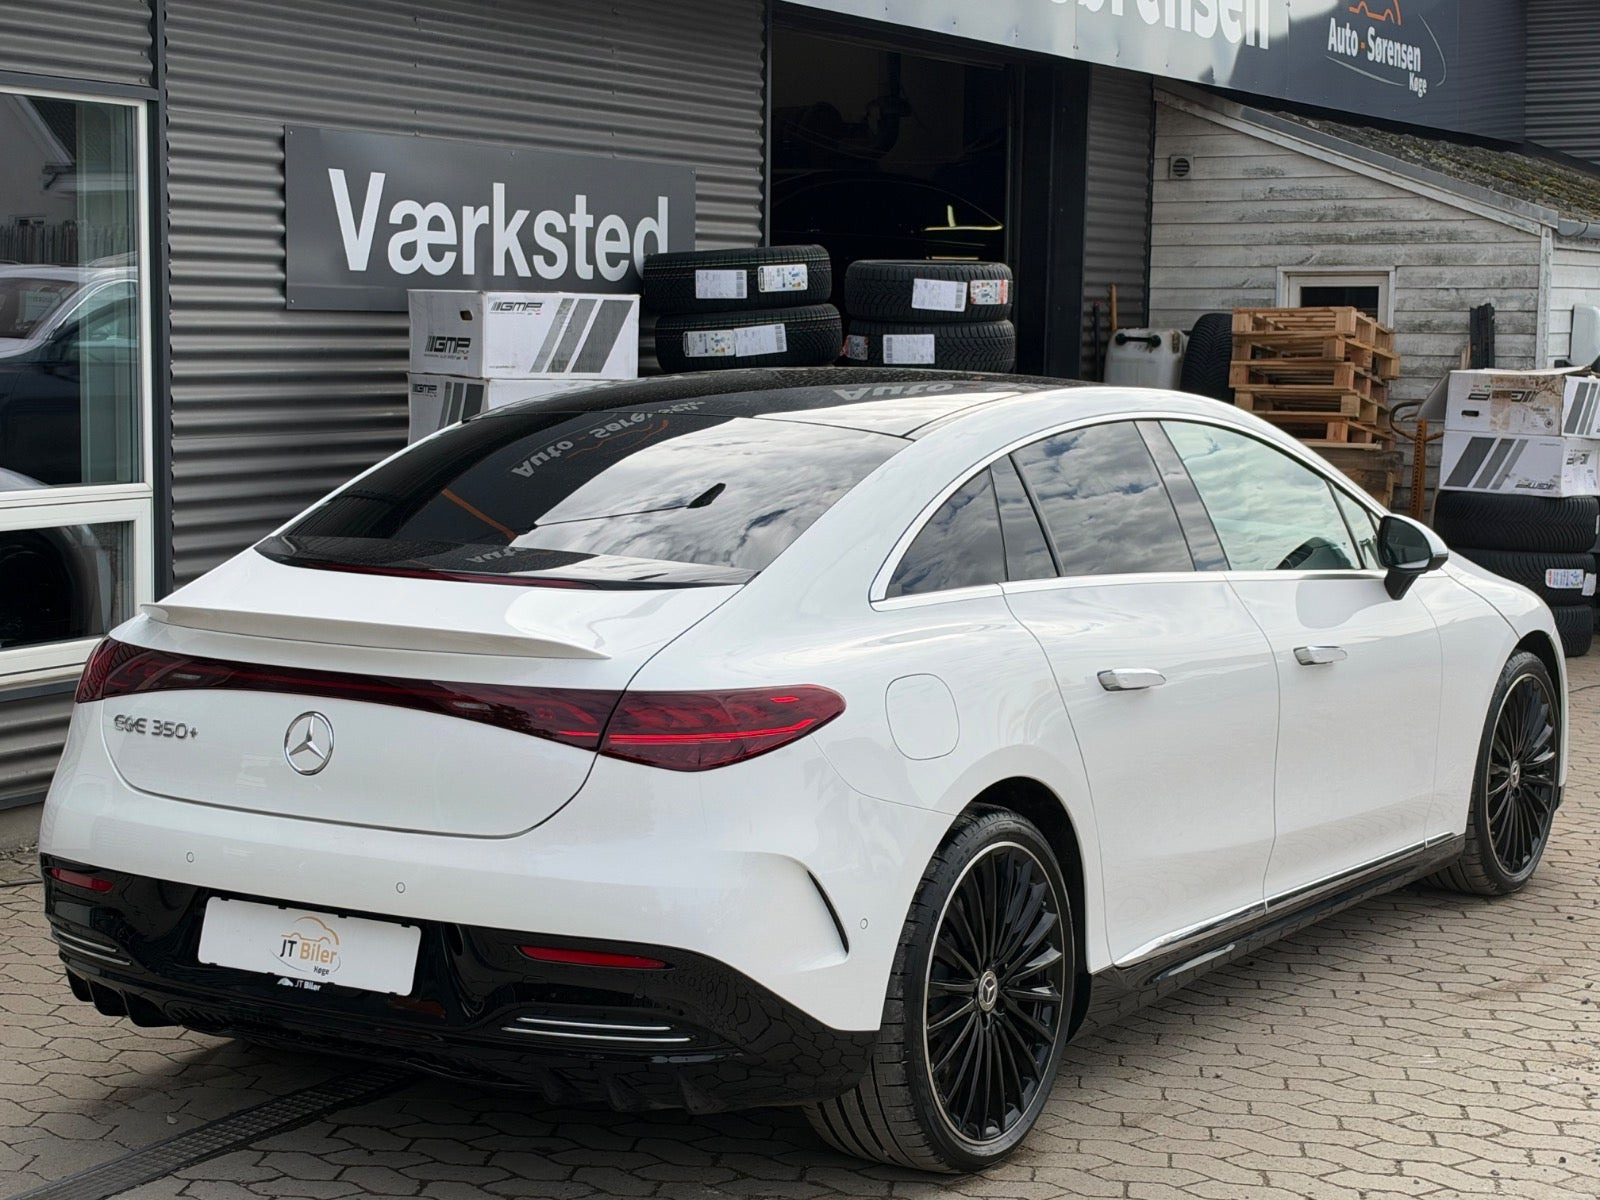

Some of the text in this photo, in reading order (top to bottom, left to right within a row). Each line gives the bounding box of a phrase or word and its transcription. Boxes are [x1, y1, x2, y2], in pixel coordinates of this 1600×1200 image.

[1328, 17, 1359, 57] Auto
[1367, 26, 1421, 72] Sørensen
[1409, 72, 1428, 98] Køge
[328, 168, 668, 282] Værksted
[500, 302, 543, 312] GMP
[434, 336, 471, 353] GMP
[114, 714, 199, 739] EQE 350+
[280, 939, 337, 964] JT Biler
[295, 979, 321, 991] JT Biler
